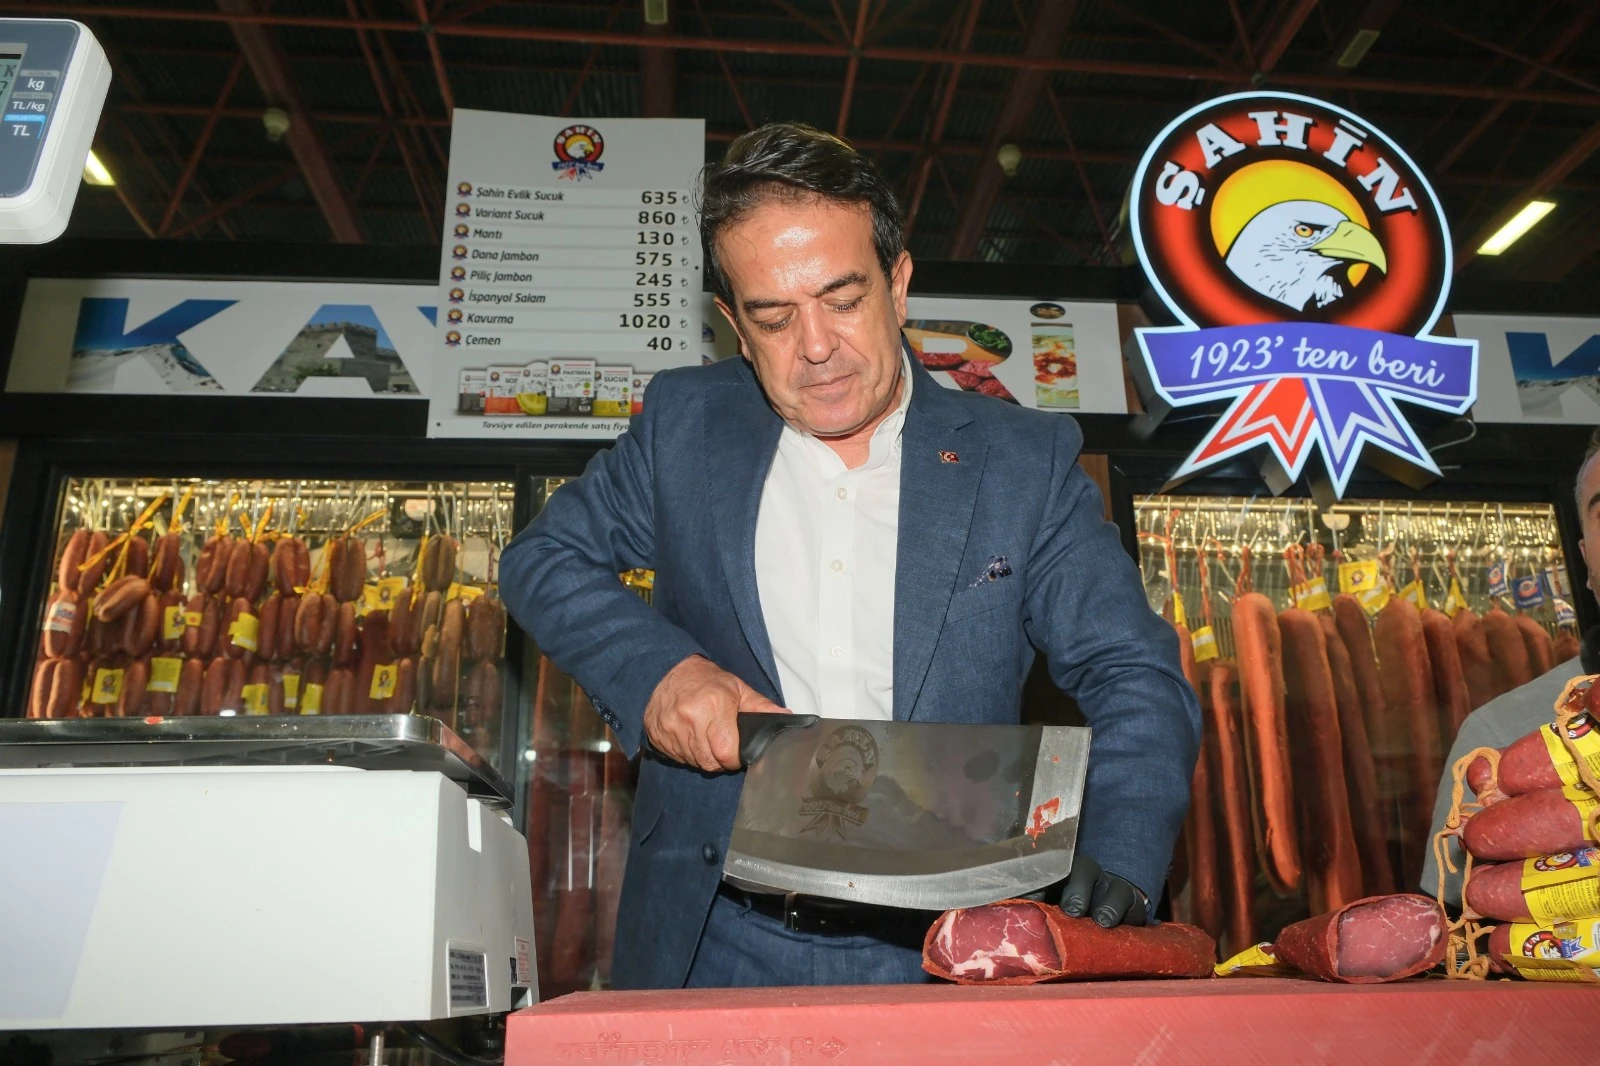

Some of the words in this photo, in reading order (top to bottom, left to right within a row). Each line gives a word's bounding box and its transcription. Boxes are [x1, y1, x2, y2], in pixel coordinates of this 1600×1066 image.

[27, 78, 45, 91] kg
[12, 101, 46, 112] TL/kg
[12, 124, 31, 136] TL
[507, 189, 531, 199] Evlik
[534, 190, 564, 201] Sucuk
[641, 190, 677, 205] 635
[475, 207, 512, 220] Variant
[514, 209, 545, 220] Sucuk
[638, 210, 676, 226] 860
[637, 231, 674, 246] 130
[471, 249, 499, 260] Dana
[500, 250, 539, 262] Jambon
[635, 251, 673, 267] 575
[492, 271, 533, 283] Jambon
[636, 272, 673, 287] 245
[514, 292, 546, 303] Salam
[633, 292, 671, 308] 555
[467, 312, 514, 324] Kavurma
[619, 313, 671, 329] 1020
[465, 334, 501, 347] Çemen
[646, 336, 672, 351] 40
[1292, 336, 1358, 371] ten
[1368, 339, 1446, 388] beri
[482, 421, 514, 430] Tavsiye
[515, 421, 542, 429] edilen
[543, 421, 589, 430] perakende
